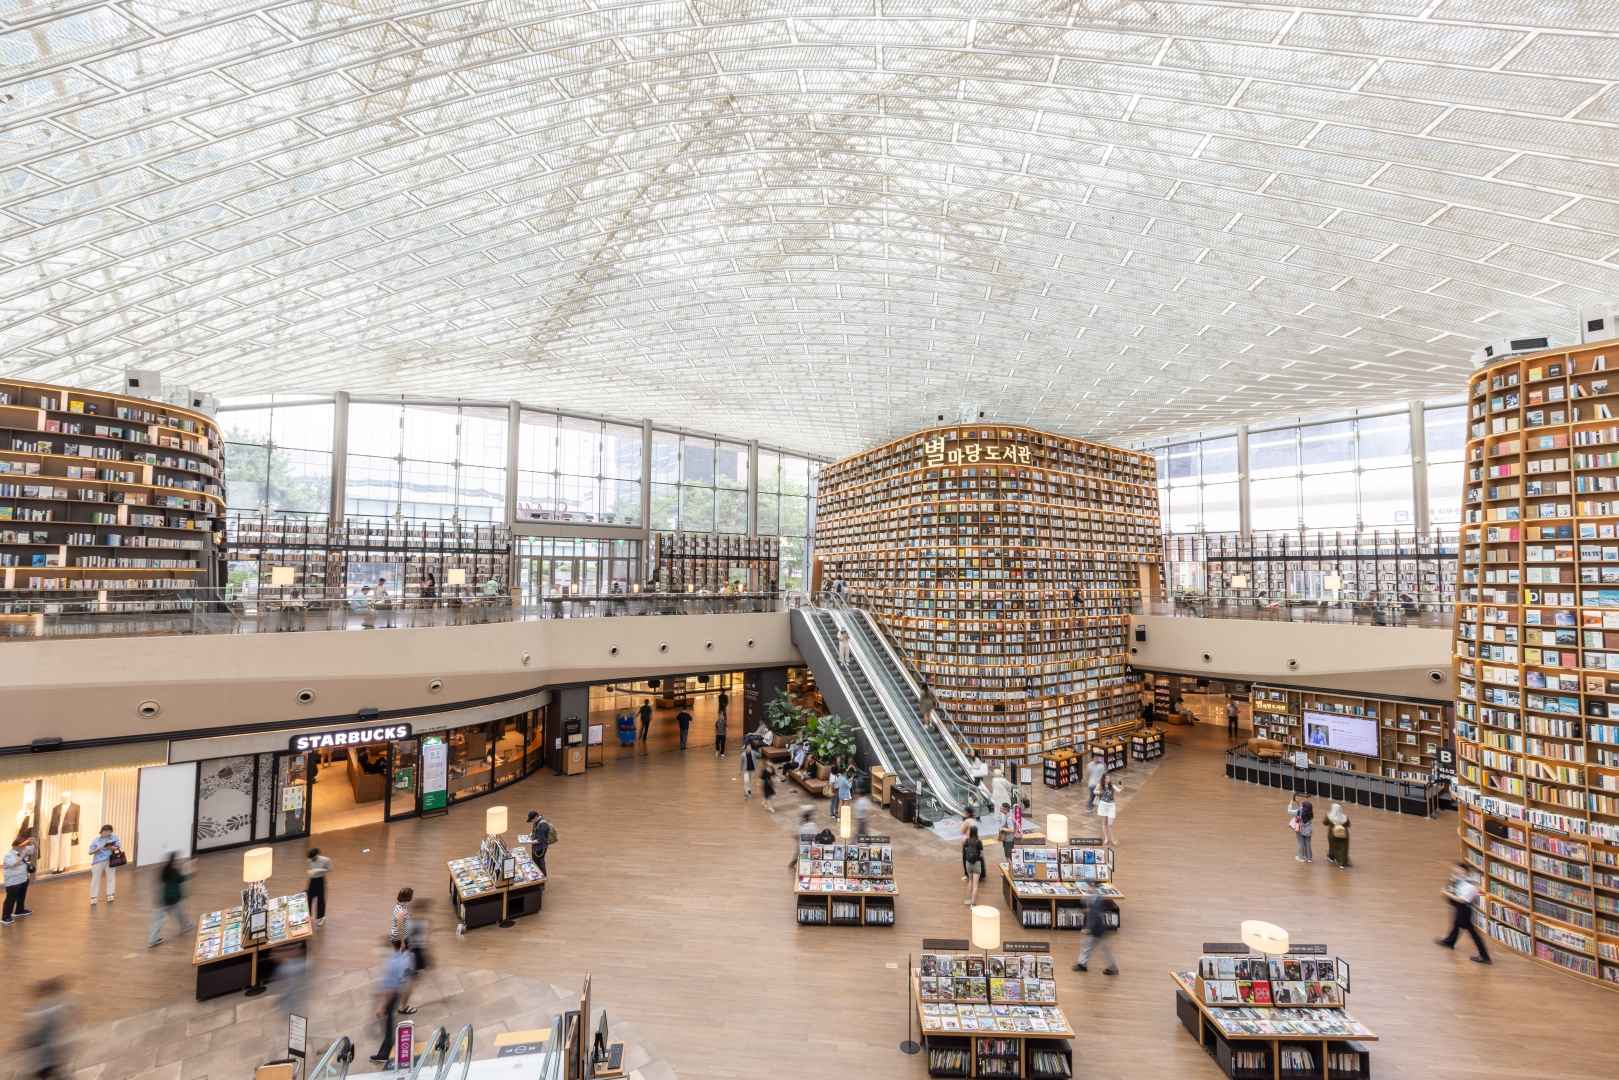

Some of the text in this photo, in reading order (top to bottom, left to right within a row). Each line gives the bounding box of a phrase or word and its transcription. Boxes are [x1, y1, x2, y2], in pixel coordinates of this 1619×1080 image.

[925, 436, 1031, 467] 별마당 도서관
[296, 726, 408, 750] STARBUCKS
[1440, 750, 1452, 763] B
